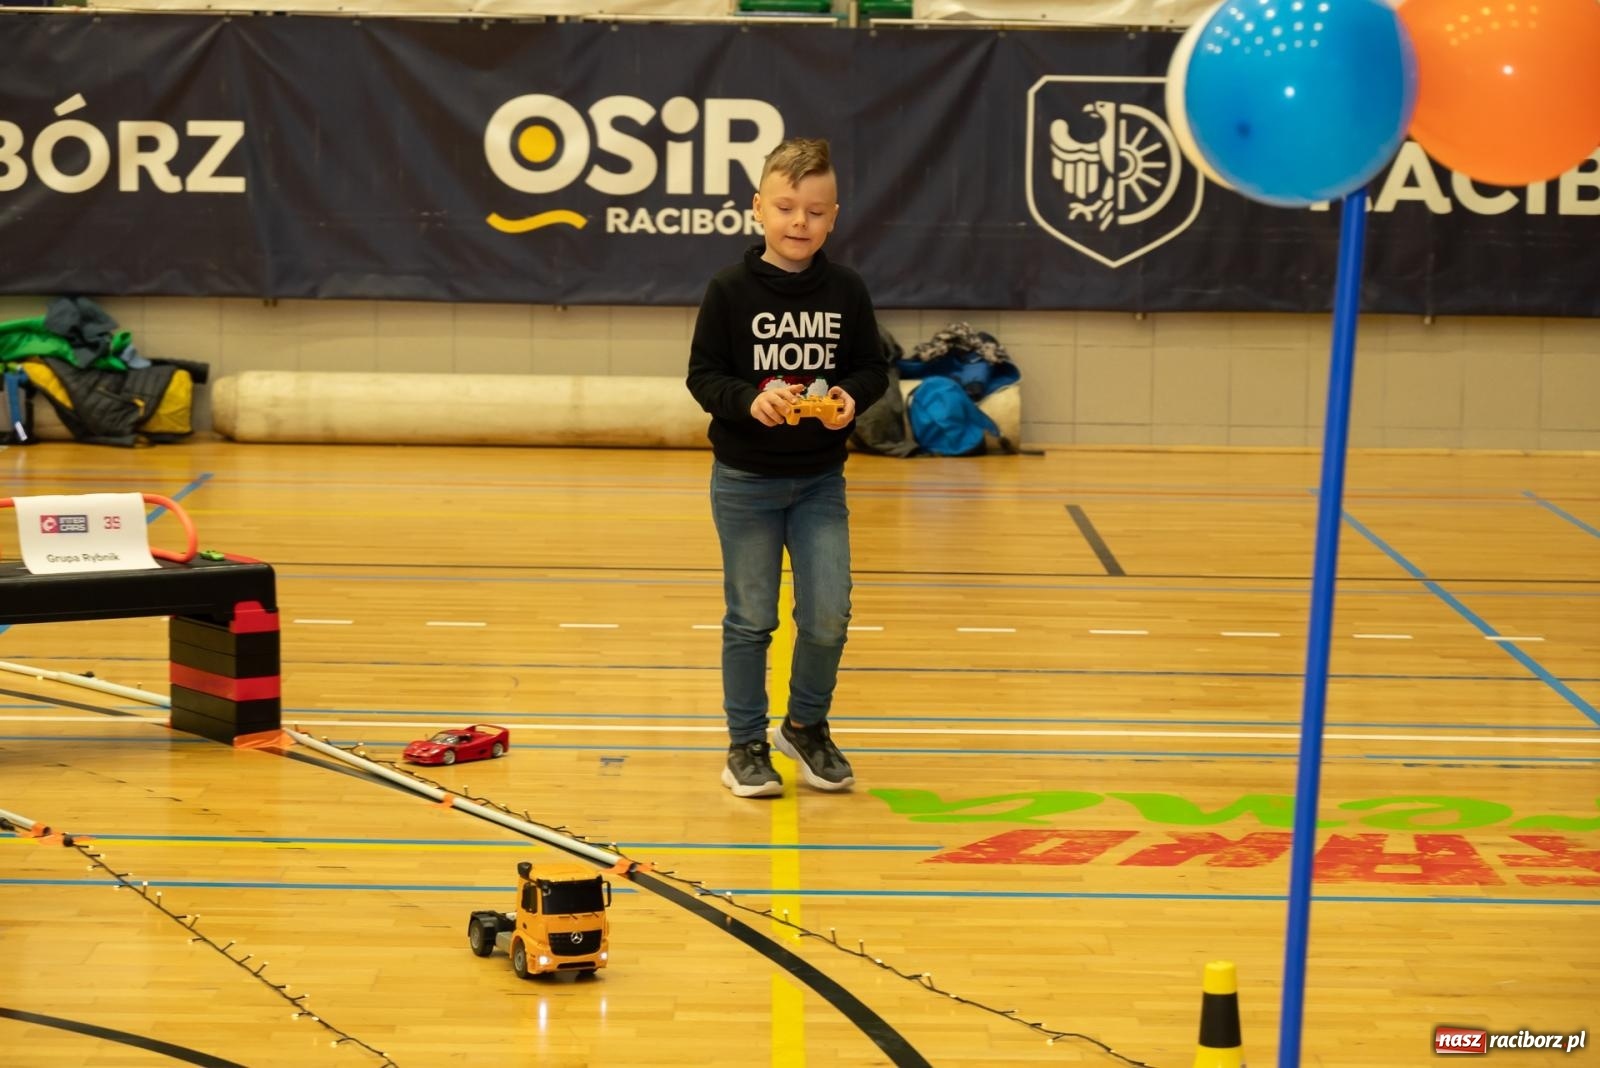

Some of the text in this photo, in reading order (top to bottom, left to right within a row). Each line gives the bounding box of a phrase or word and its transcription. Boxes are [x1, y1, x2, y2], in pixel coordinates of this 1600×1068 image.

[0, 93, 246, 194] BÓRZ
[484, 93, 785, 195] OSiR
[751, 311, 842, 340] GAME
[753, 343, 838, 371] MODE
[60, 524, 87, 532] CARS
[46, 551, 120, 564] Grupa Rybnik
